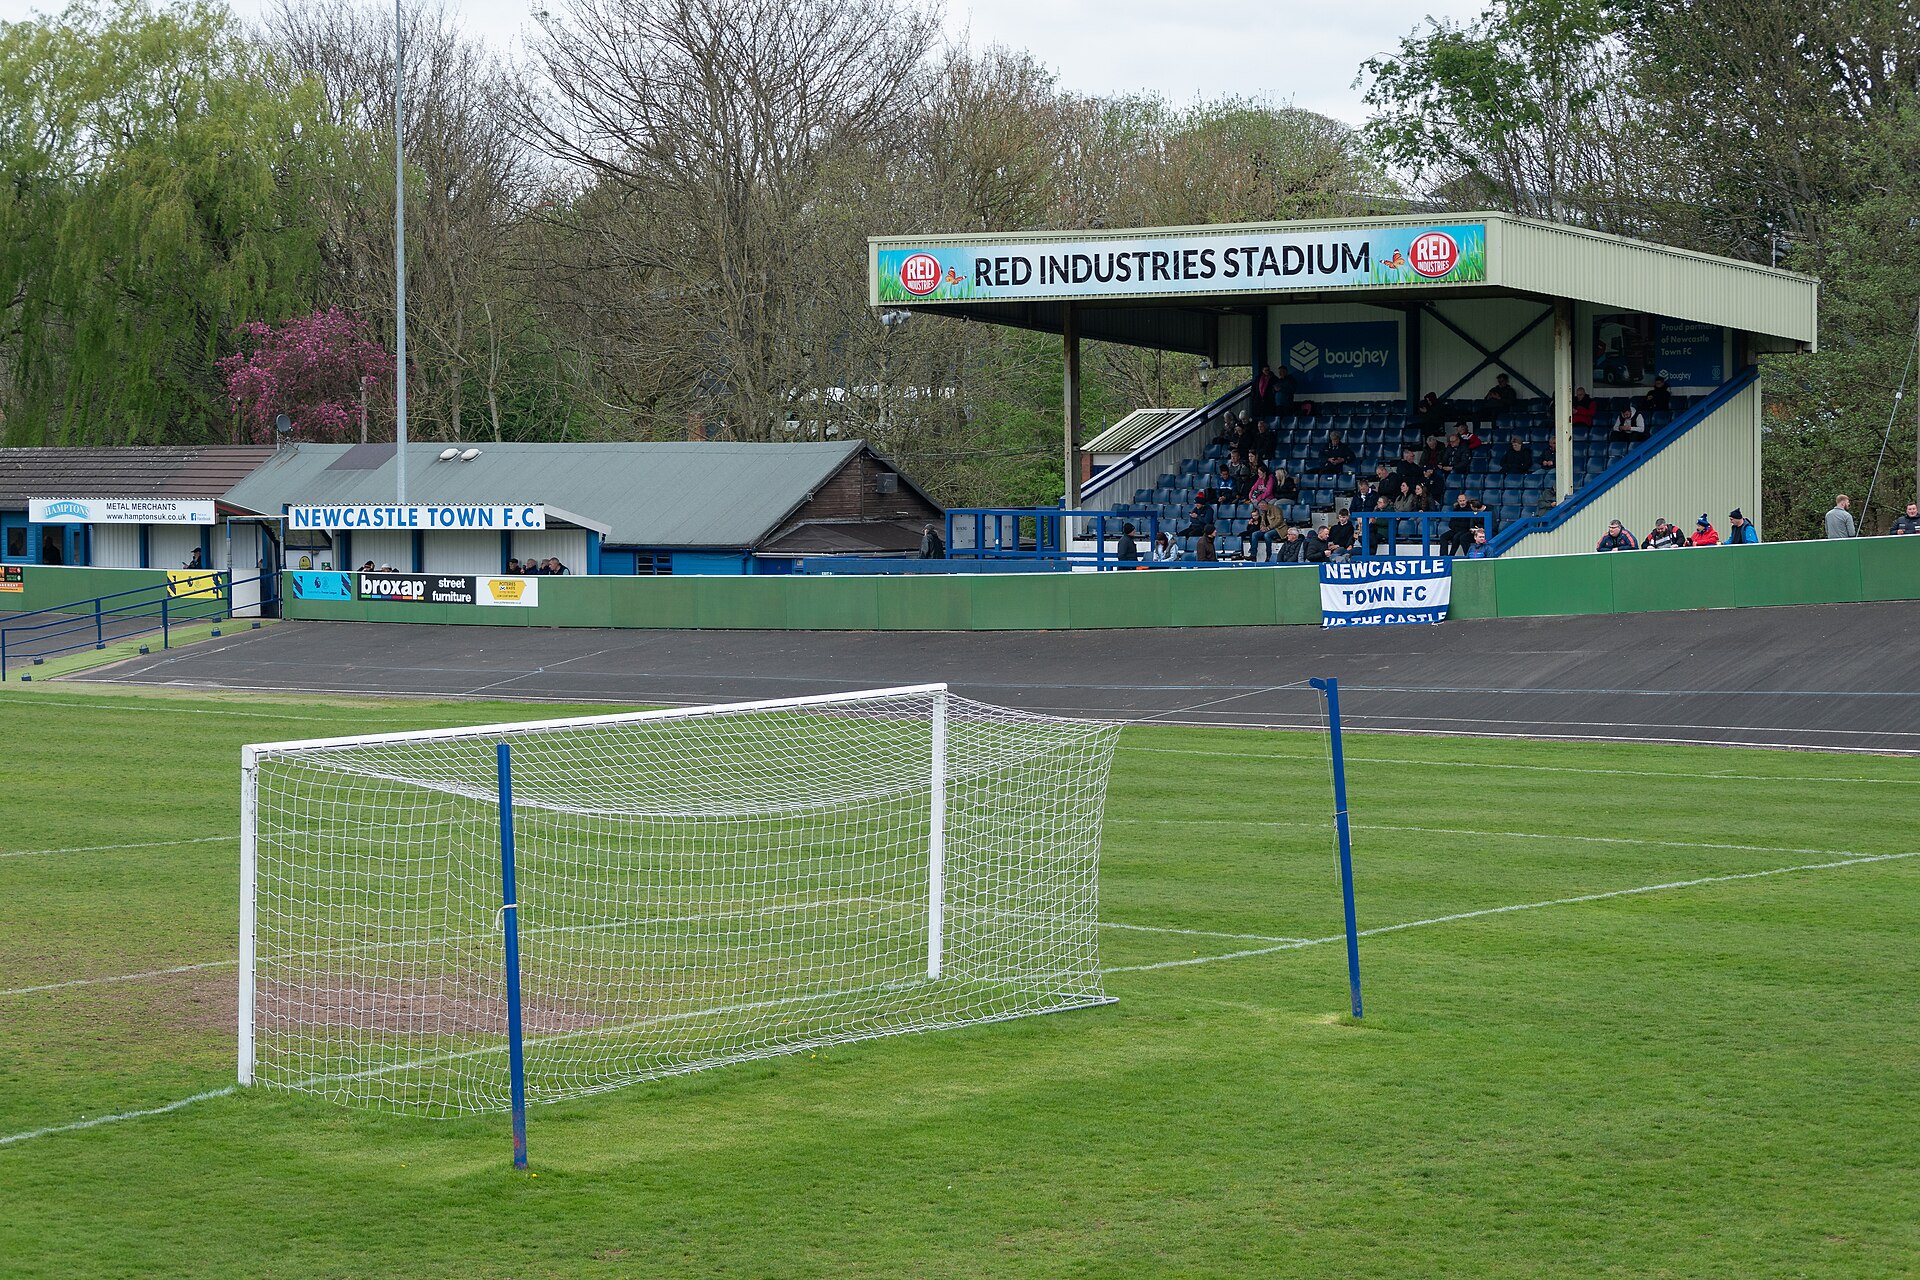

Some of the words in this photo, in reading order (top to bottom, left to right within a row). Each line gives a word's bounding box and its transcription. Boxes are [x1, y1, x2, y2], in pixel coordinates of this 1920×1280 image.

[1417, 236, 1450, 260] RED
[907, 259, 935, 280] RED
[975, 256, 1033, 287] RED
[1039, 248, 1216, 285] INDUSTRIES
[1223, 241, 1371, 278] STADIUM
[1417, 260, 1449, 272] INDUSTRIES
[907, 279, 934, 291] INDUSTRIES
[1661, 323, 1683, 331] Proud
[1684, 324, 1717, 333] partners
[1661, 335, 1669, 343] of
[1670, 334, 1710, 343] Newcastle
[1325, 347, 1389, 367] boughey
[1661, 348, 1681, 356] Town
[1682, 347, 1692, 355] FC
[1669, 372, 1691, 380] boughey
[45, 503, 89, 516] HAMPTONS
[106, 503, 130, 511] METAL
[131, 503, 177, 511] MERCHANTS
[106, 513, 187, 522] www.hamptonsuk.co.uk
[295, 507, 418, 527] NEWCASTLE
[427, 507, 493, 527] TOWN
[503, 507, 541, 527] F.C.
[1325, 559, 1445, 579] NEWCASTLE
[361, 575, 424, 600] broxap
[438, 578, 466, 589] street
[432, 590, 472, 603] furniture
[1342, 586, 1395, 605] TOWN
[1402, 585, 1427, 602] FC
